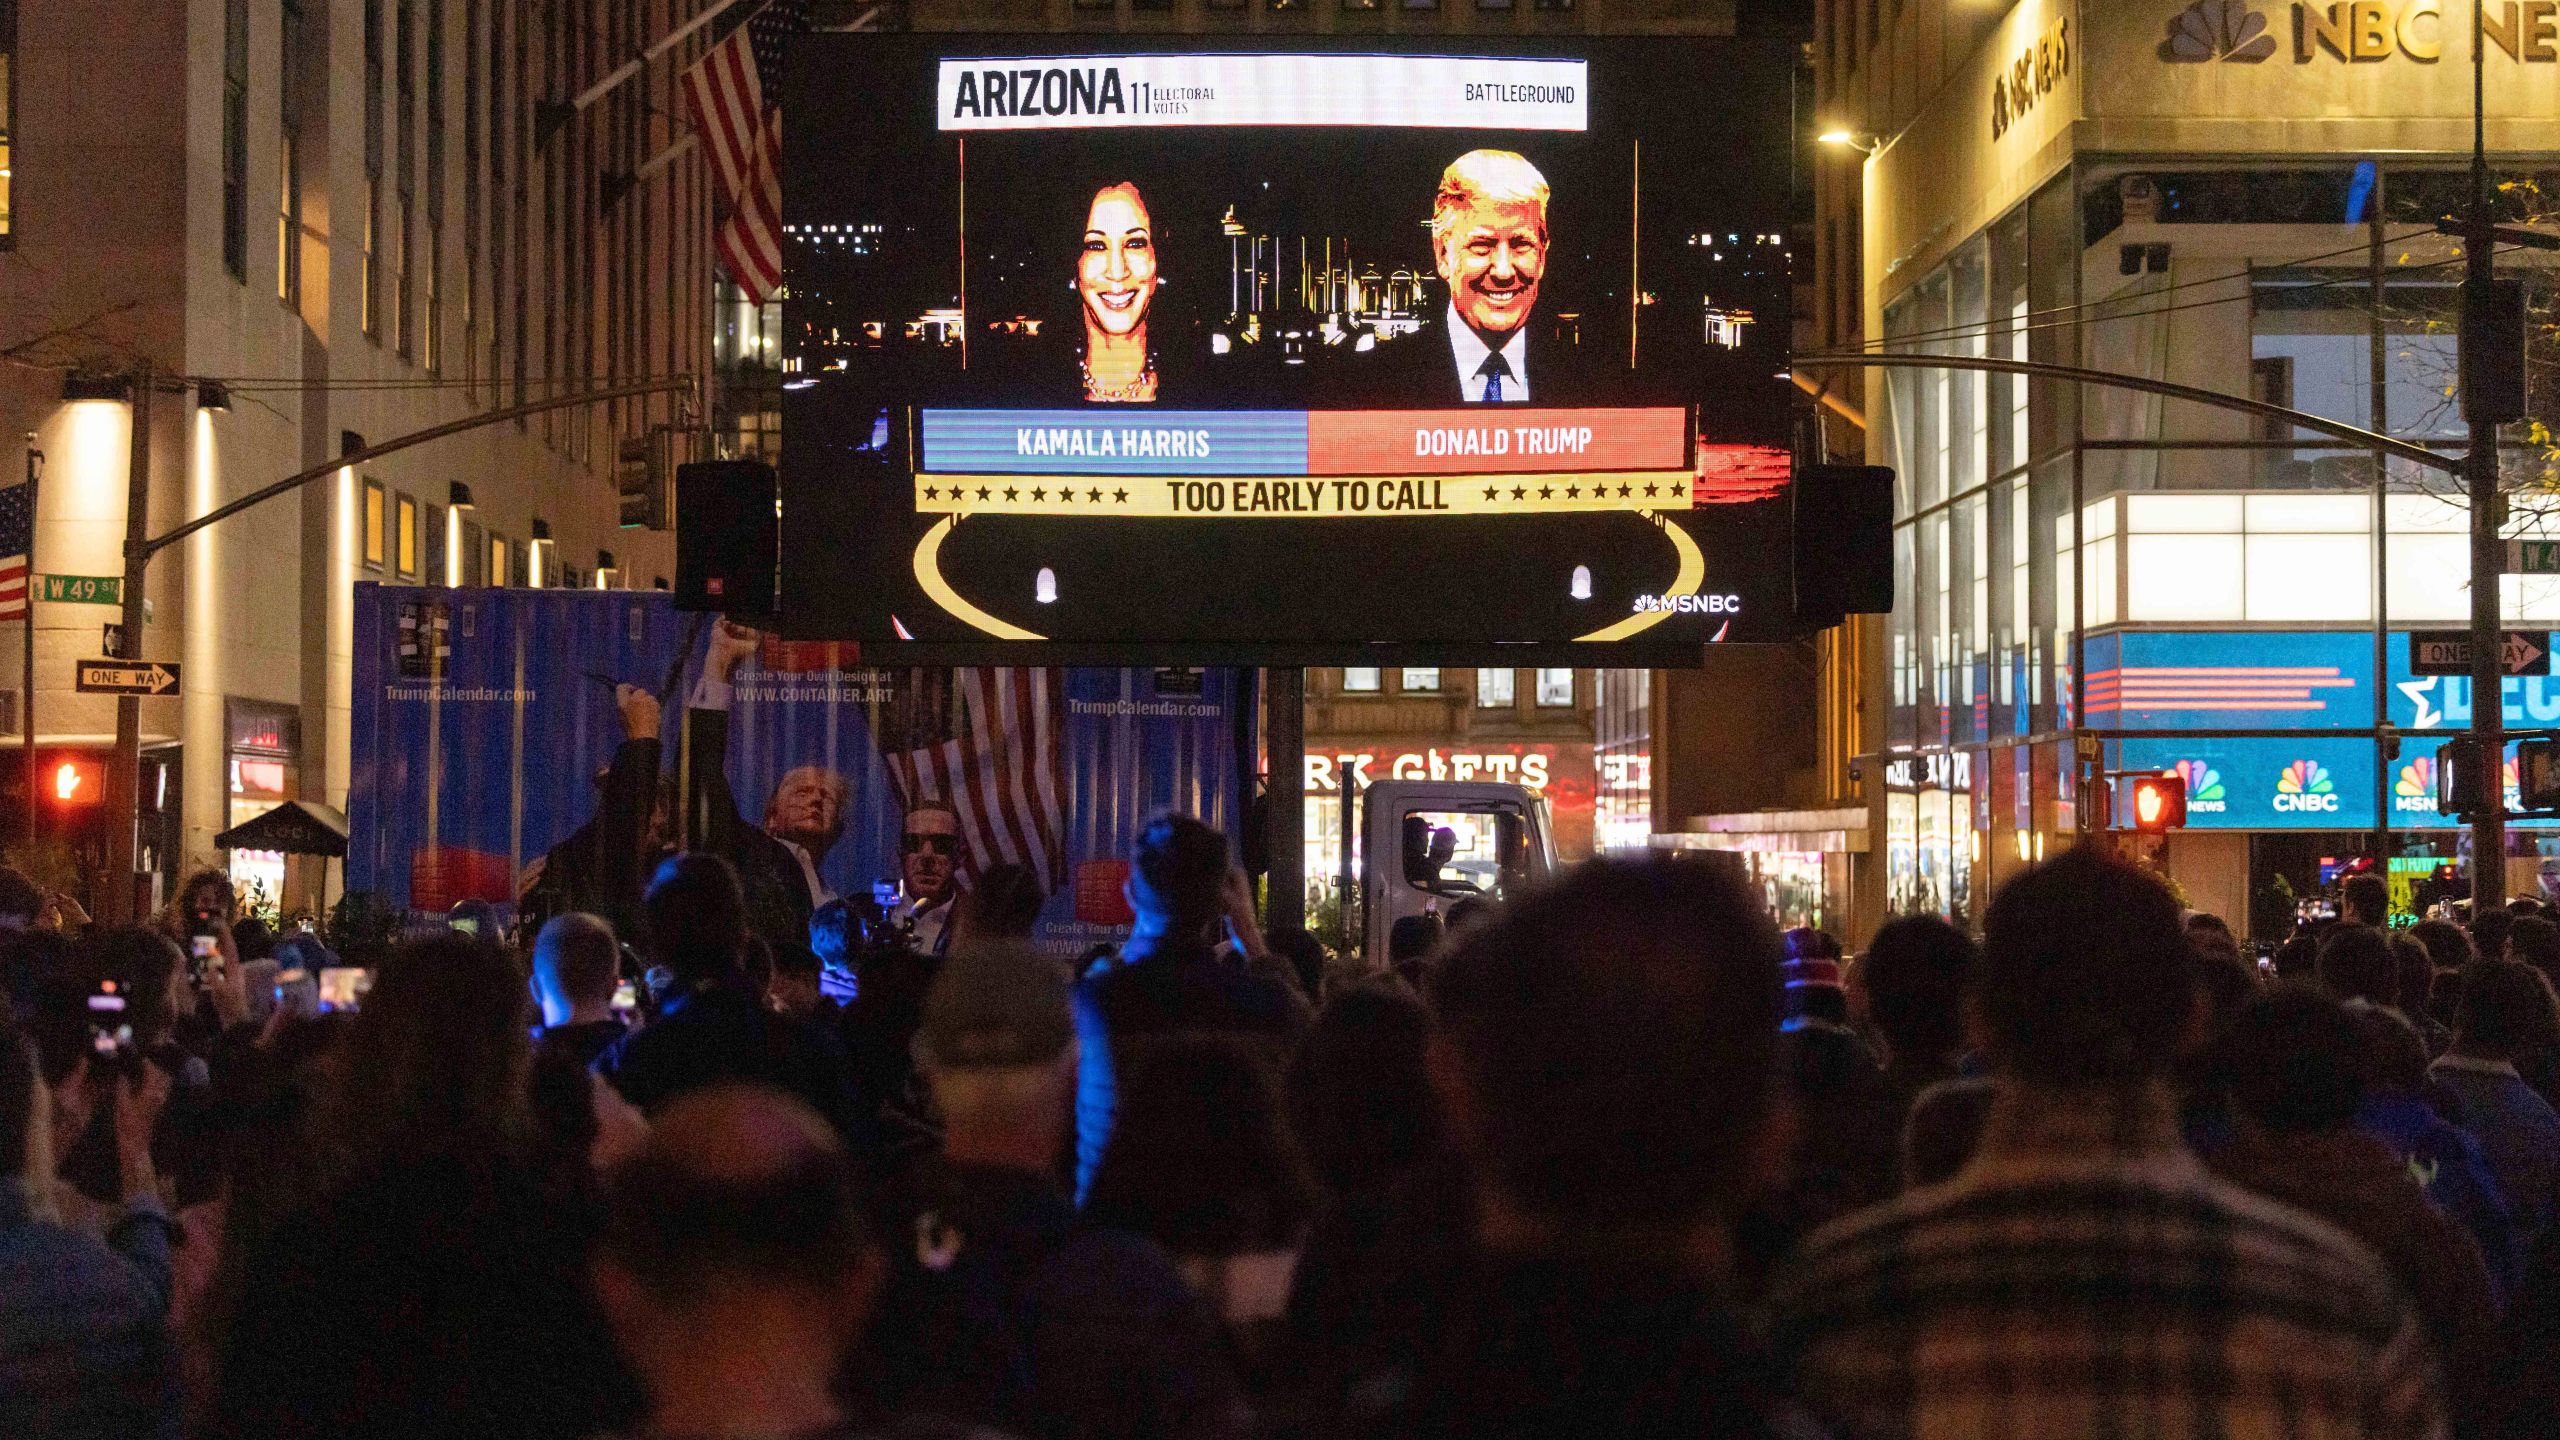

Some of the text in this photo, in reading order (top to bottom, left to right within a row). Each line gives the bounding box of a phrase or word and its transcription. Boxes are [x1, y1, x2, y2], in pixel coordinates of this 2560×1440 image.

[2291, 0, 2560, 64] NBC NE
[953, 67, 1150, 118] ARIZONA 11
[1153, 88, 1215, 101] ELECTORAL
[1465, 83, 1575, 104] BATTLEGROUND
[1153, 102, 1188, 115] VOTES
[1017, 428, 1210, 458] KAMALA HARRIS
[1415, 427, 1593, 456] DONALD TRUMP
[1166, 480, 1449, 512] TOO EARLY TO CALL
[2527, 544, 2540, 570] W
[50, 578, 65, 599] W
[69, 580, 96, 600] 49
[1660, 594, 1740, 613] MSNBC
[2503, 645, 2528, 661] AY
[91, 670, 166, 686] ONE WAY
[735, 669, 892, 685] Create Your Own Design at
[385, 685, 536, 703] TrumpCalendar.com
[735, 687, 894, 702] WWW.CONTAINER.ART
[1068, 698, 1221, 717] TrumpCalendar.com
[1302, 754, 1374, 790] RK
[2187, 800, 2226, 812] NEWS
[2272, 793, 2339, 812] CNBC
[2396, 796, 2438, 811] MSN
